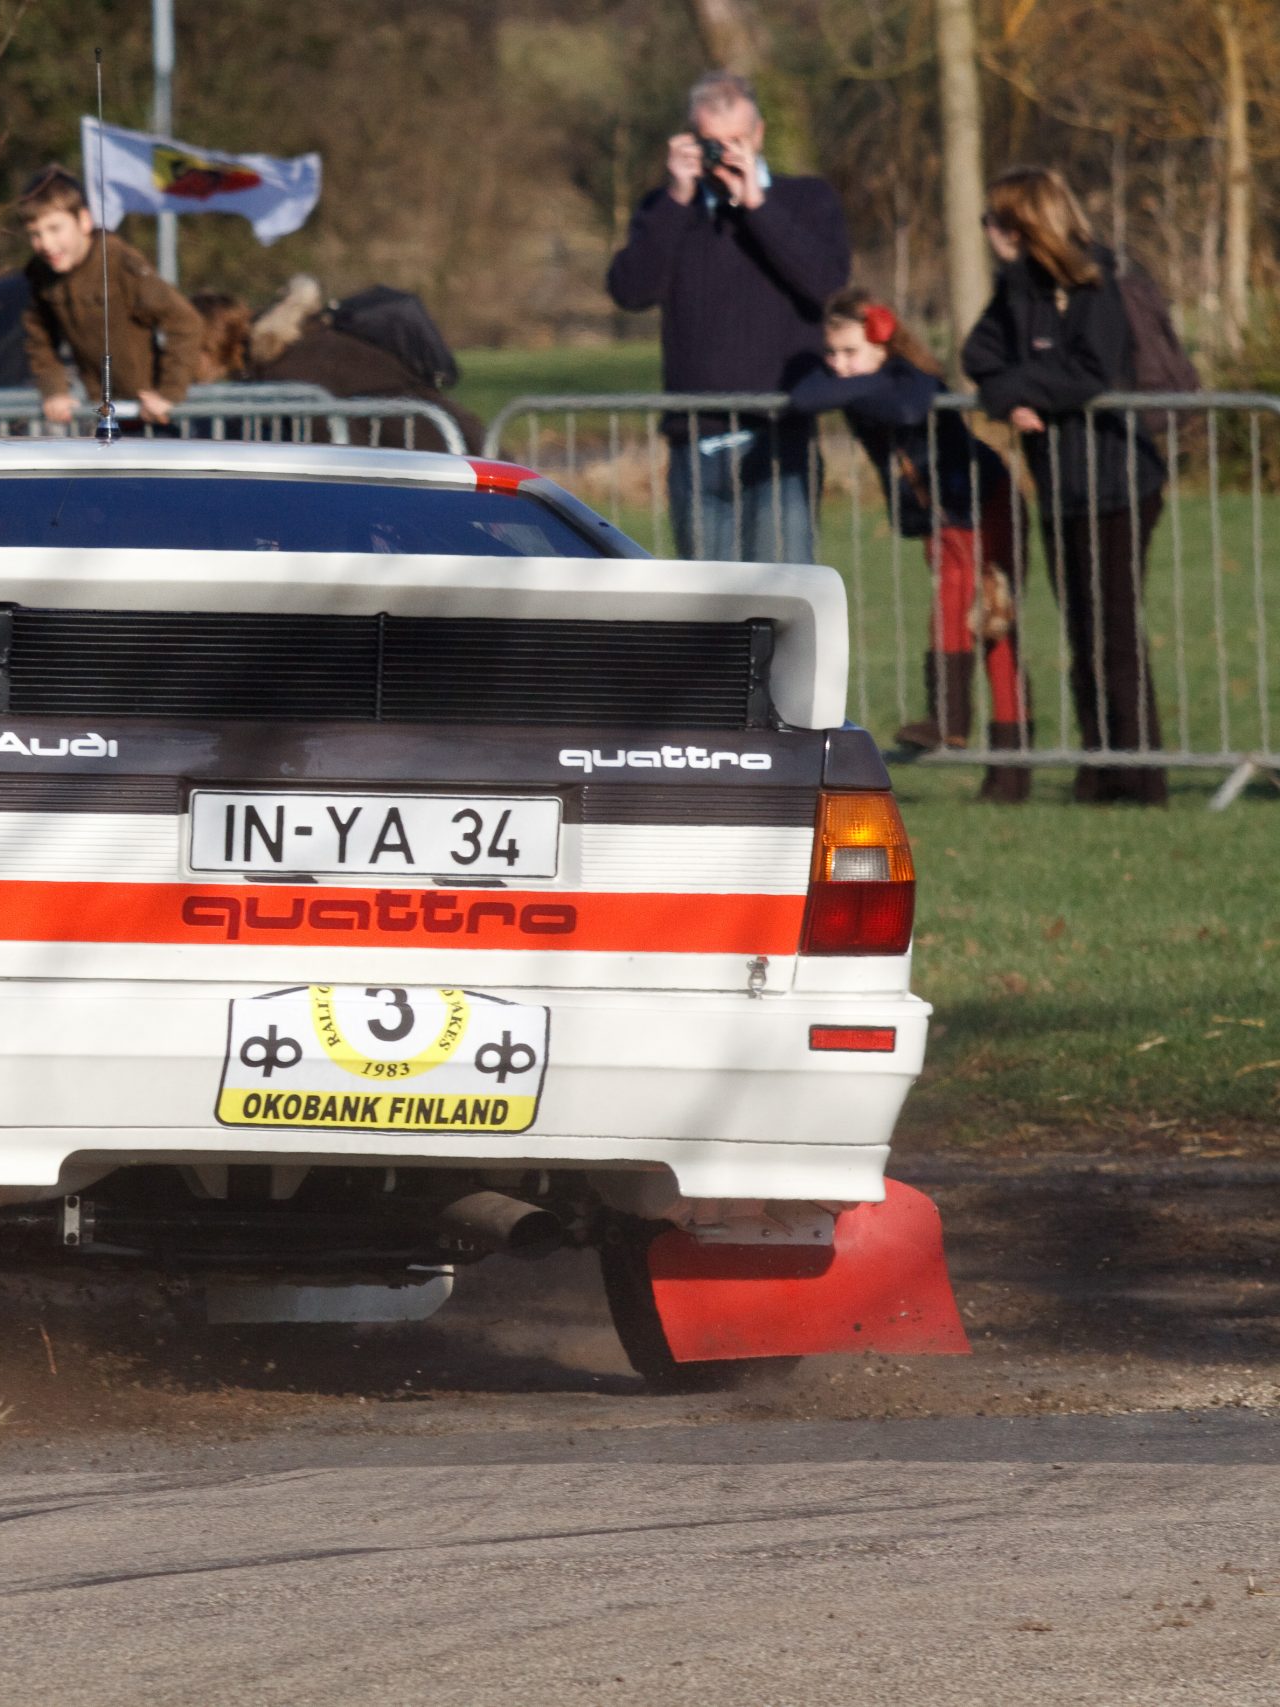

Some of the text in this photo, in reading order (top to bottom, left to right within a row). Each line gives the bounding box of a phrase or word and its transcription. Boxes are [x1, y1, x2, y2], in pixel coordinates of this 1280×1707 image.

[558, 746, 772, 773] quattro
[224, 804, 520, 867] IN-YA 34
[181, 889, 577, 940] quattro
[365, 987, 415, 1042] 3
[361, 1061, 411, 1078] 1983
[242, 1093, 510, 1126] OKOBANK FINLAND
